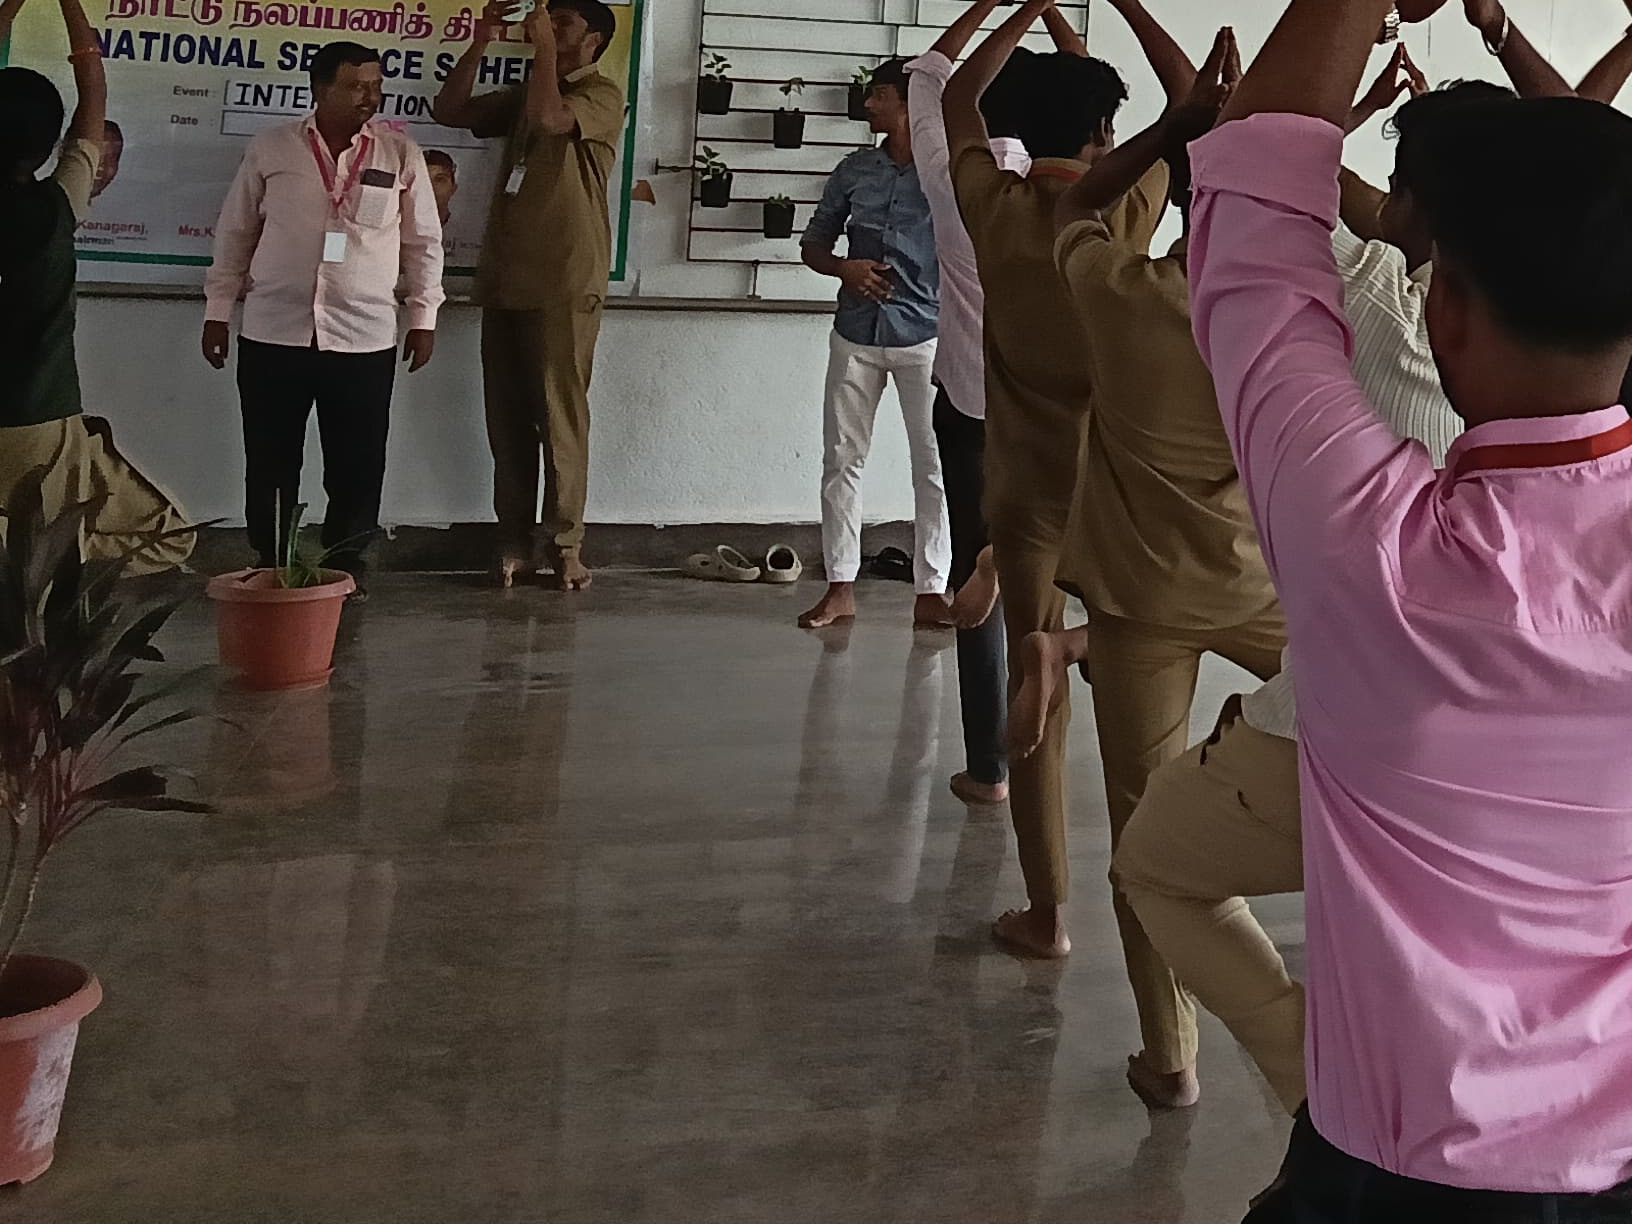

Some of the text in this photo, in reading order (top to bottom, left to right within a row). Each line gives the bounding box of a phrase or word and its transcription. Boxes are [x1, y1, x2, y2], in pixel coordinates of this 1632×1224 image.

[95, 28, 535, 85] NATIONAL SECE SHE
[173, 85, 209, 98] Event
[170, 114, 198, 125] Date
